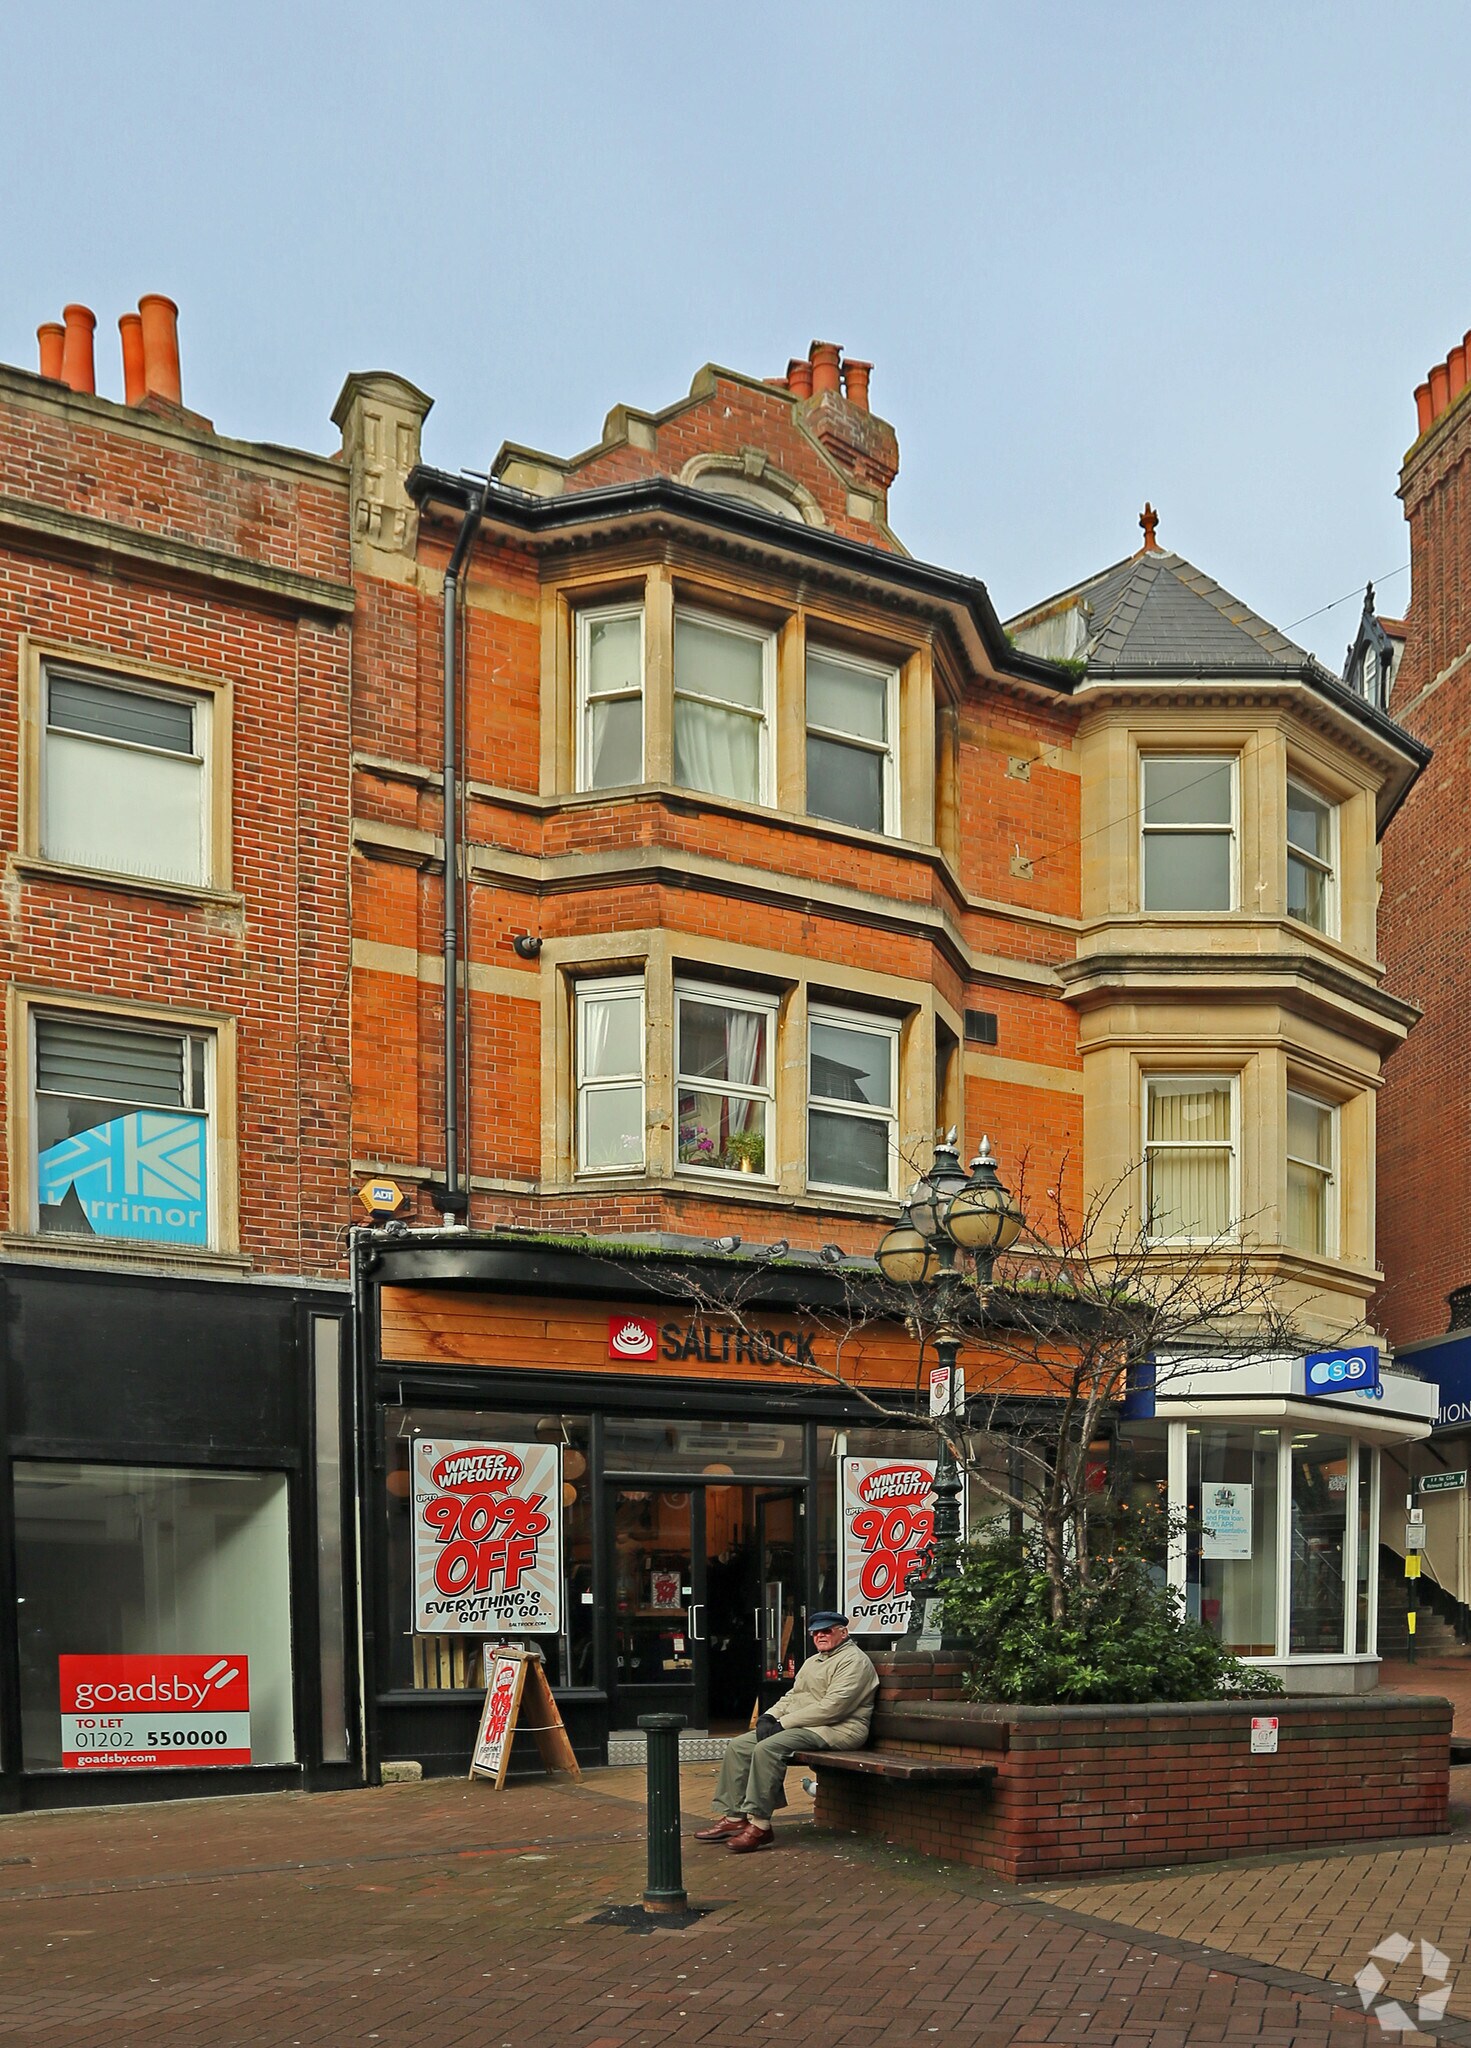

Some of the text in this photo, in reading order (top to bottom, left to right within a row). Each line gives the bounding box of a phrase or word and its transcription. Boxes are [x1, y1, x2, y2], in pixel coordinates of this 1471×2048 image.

[374, 1190, 394, 1200] ADT
[48, 1191, 202, 1229] krrimor
[662, 1323, 817, 1366] SALTROCK
[444, 1454, 507, 1474] WINTER
[438, 1466, 519, 1488] WIPEOUT!!
[869, 1471, 922, 1488] WINTER
[864, 1481, 931, 1502] WIPEOUT!!
[423, 1492, 551, 1543] 90%
[434, 1538, 538, 1597] OFF
[860, 1548, 934, 1602] OF
[425, 1591, 541, 1614] EVERYTHING'S
[852, 1601, 912, 1617] EVERYTH
[459, 1605, 552, 1623] GOT TO GO...
[881, 1613, 906, 1625] GOT
[75, 1675, 211, 1710] goadsby
[76, 1718, 124, 1729] TO LET
[75, 1730, 228, 1748] 01202 550000
[77, 1753, 157, 1767] goadsby.com
